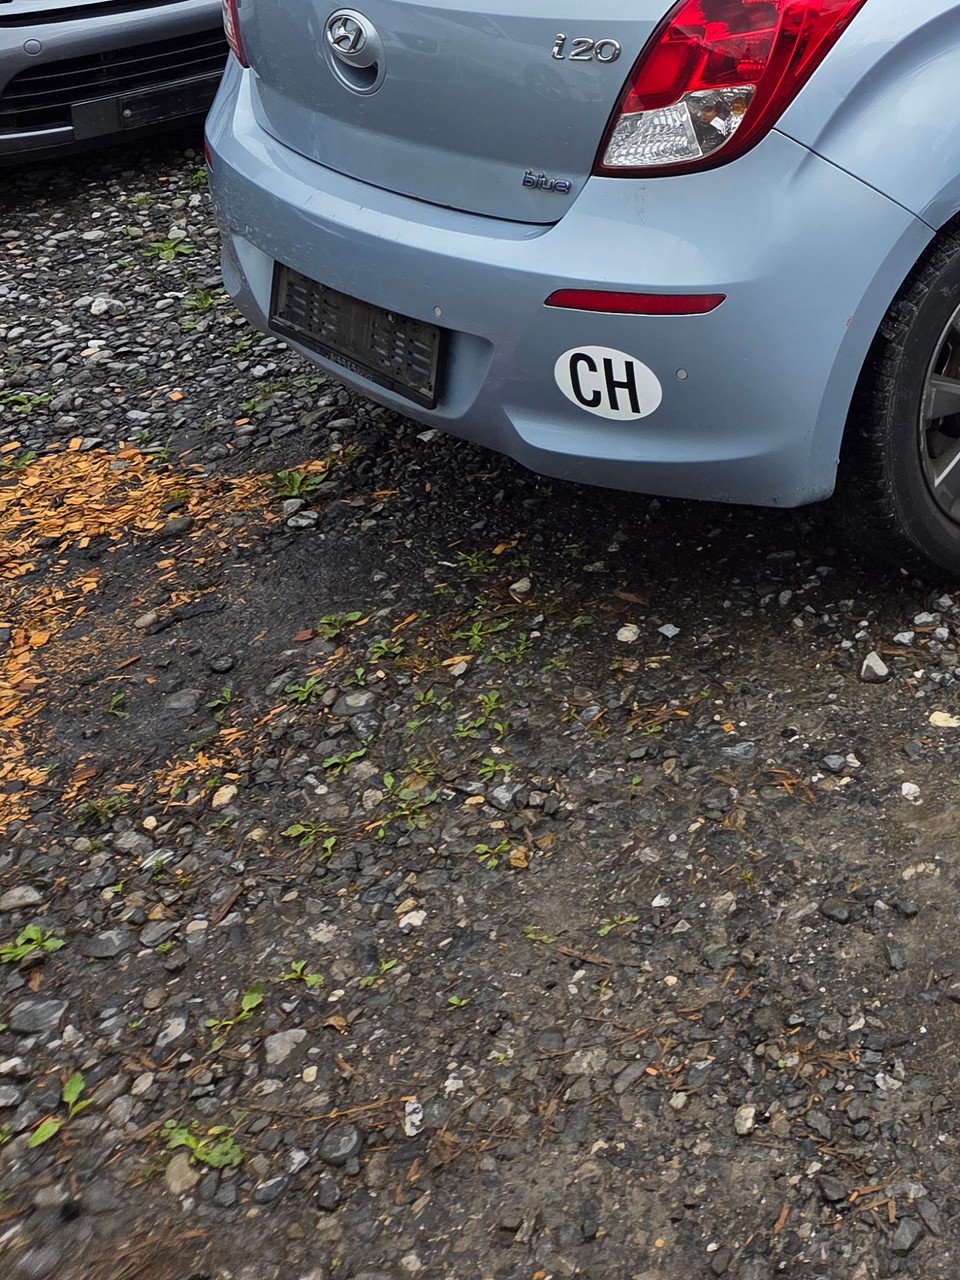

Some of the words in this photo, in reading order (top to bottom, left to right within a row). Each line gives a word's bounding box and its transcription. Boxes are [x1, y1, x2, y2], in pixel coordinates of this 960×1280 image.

[551, 32, 622, 64] i20
[522, 168, 573, 195] blue
[569, 352, 641, 414] CH
